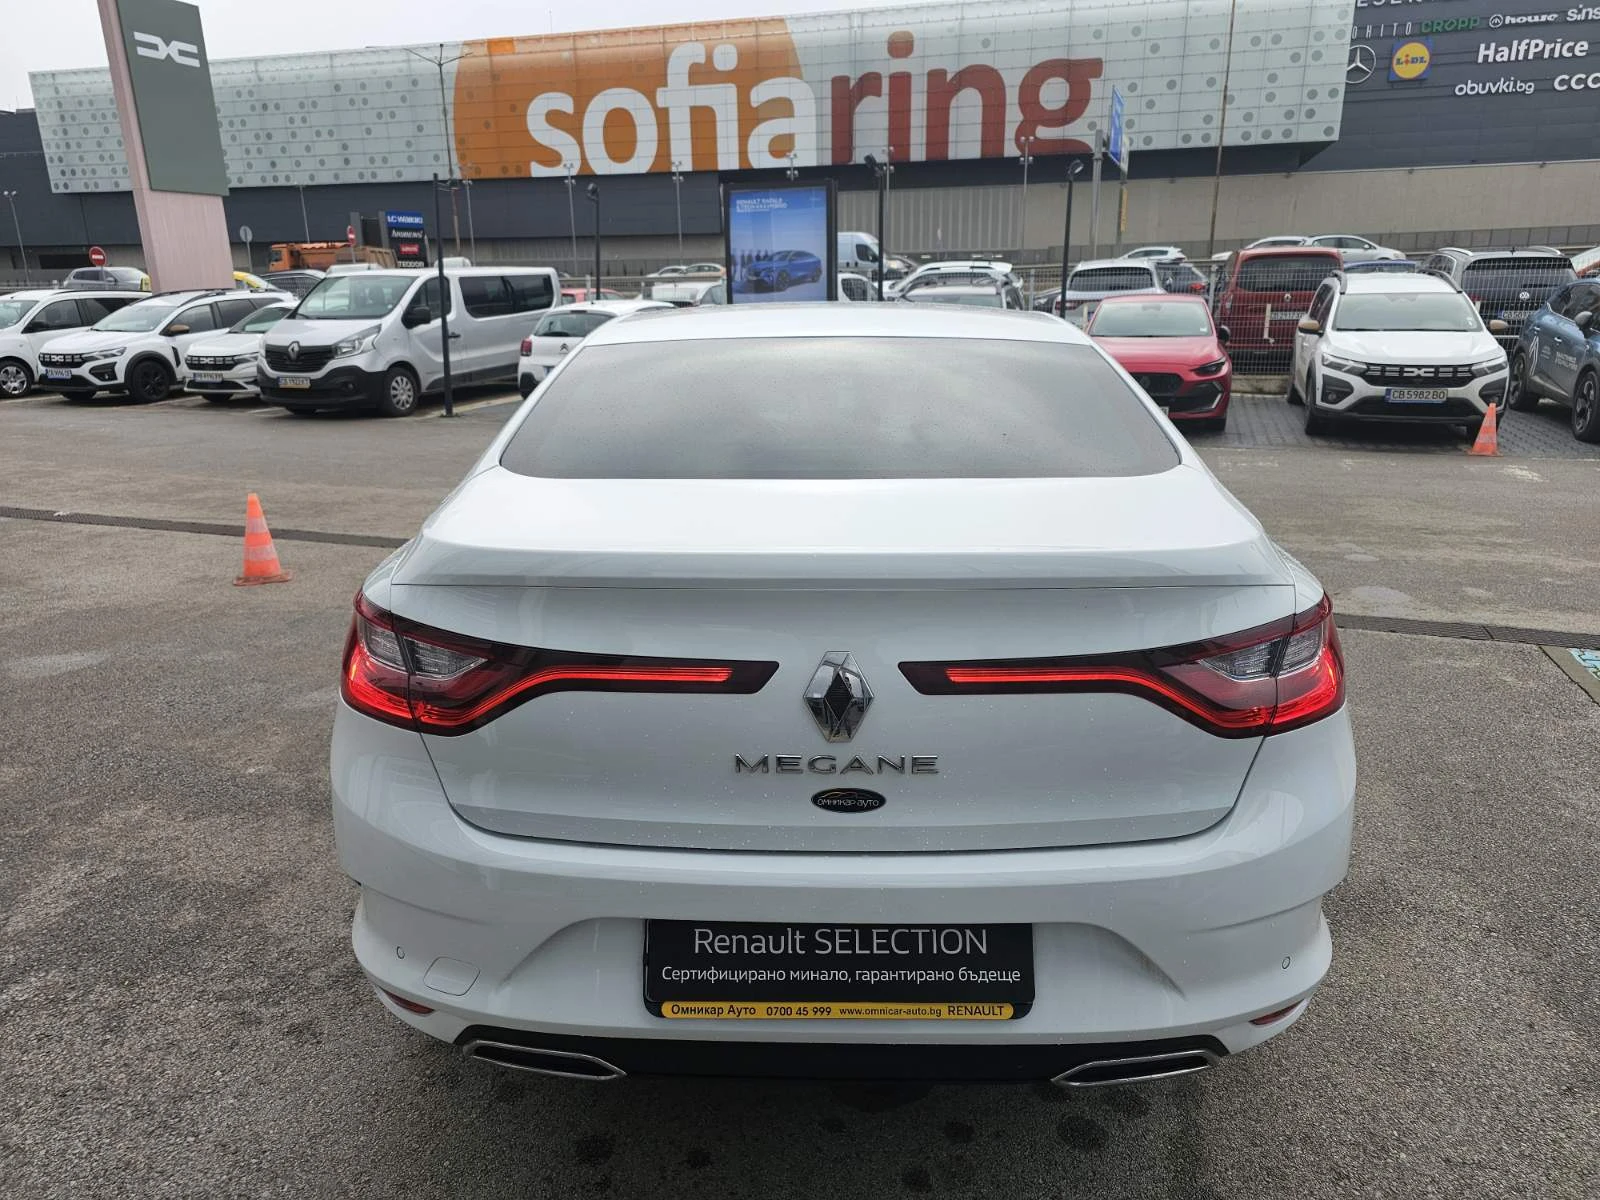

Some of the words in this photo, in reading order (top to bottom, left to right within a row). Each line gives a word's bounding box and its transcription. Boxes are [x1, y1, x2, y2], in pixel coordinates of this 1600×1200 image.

[1421, 17, 1480, 33] CROPP
[1477, 38, 1589, 64] HalfPrice
[1454, 76, 1535, 96] obuvki.bg
[1553, 72, 1600, 92] CCC
[734, 753, 940, 775] MEGANE
[693, 928, 806, 954] Renault
[814, 928, 988, 954] SELECTION
[662, 966, 786, 984] Сертифицирано
[790, 969, 851, 983] минало,
[855, 969, 954, 984] гарантирано
[958, 966, 1021, 984] бъдеще
[671, 1004, 724, 1017] Омникар
[727, 1004, 757, 1018] Ауто
[766, 1006, 793, 1016] 0700
[796, 1006, 809, 1016] 45
[812, 1006, 832, 1016] 999
[839, 1006, 942, 1017] www.omnicar-auto.bg
[947, 1005, 1005, 1016] RENAULT
